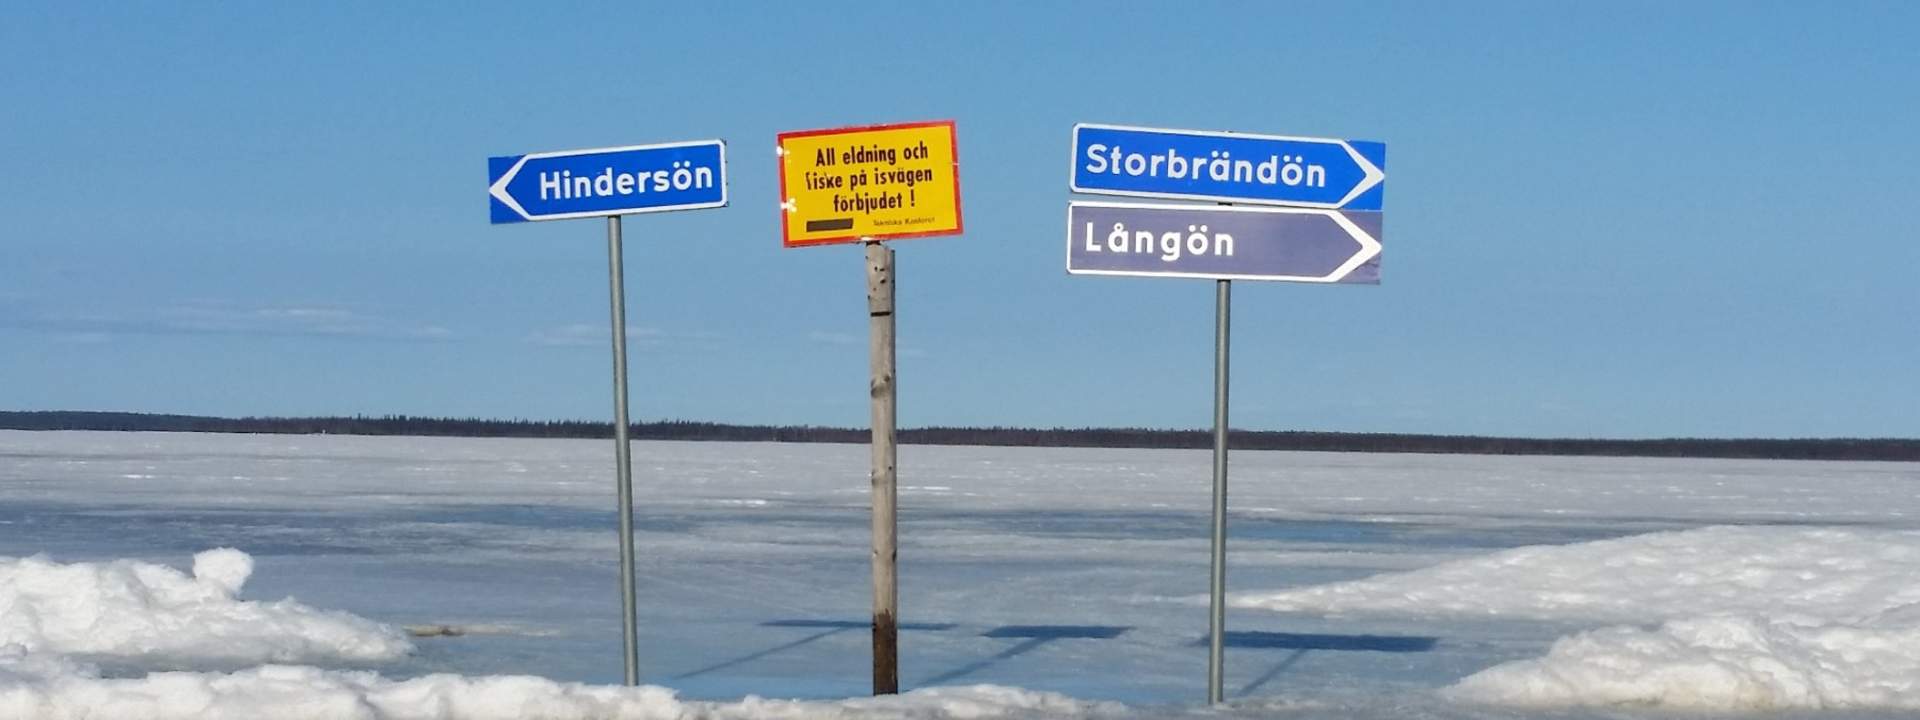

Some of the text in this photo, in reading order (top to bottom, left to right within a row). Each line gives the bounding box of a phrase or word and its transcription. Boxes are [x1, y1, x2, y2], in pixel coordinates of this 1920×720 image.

[815, 140, 928, 167] All eldning och
[1086, 143, 1326, 188] Storbrändön
[540, 160, 713, 201] Hindersön
[850, 169, 867, 190] på
[874, 168, 933, 187] isvägen
[833, 191, 903, 214] förbjudet
[1085, 221, 1234, 261] Långön
